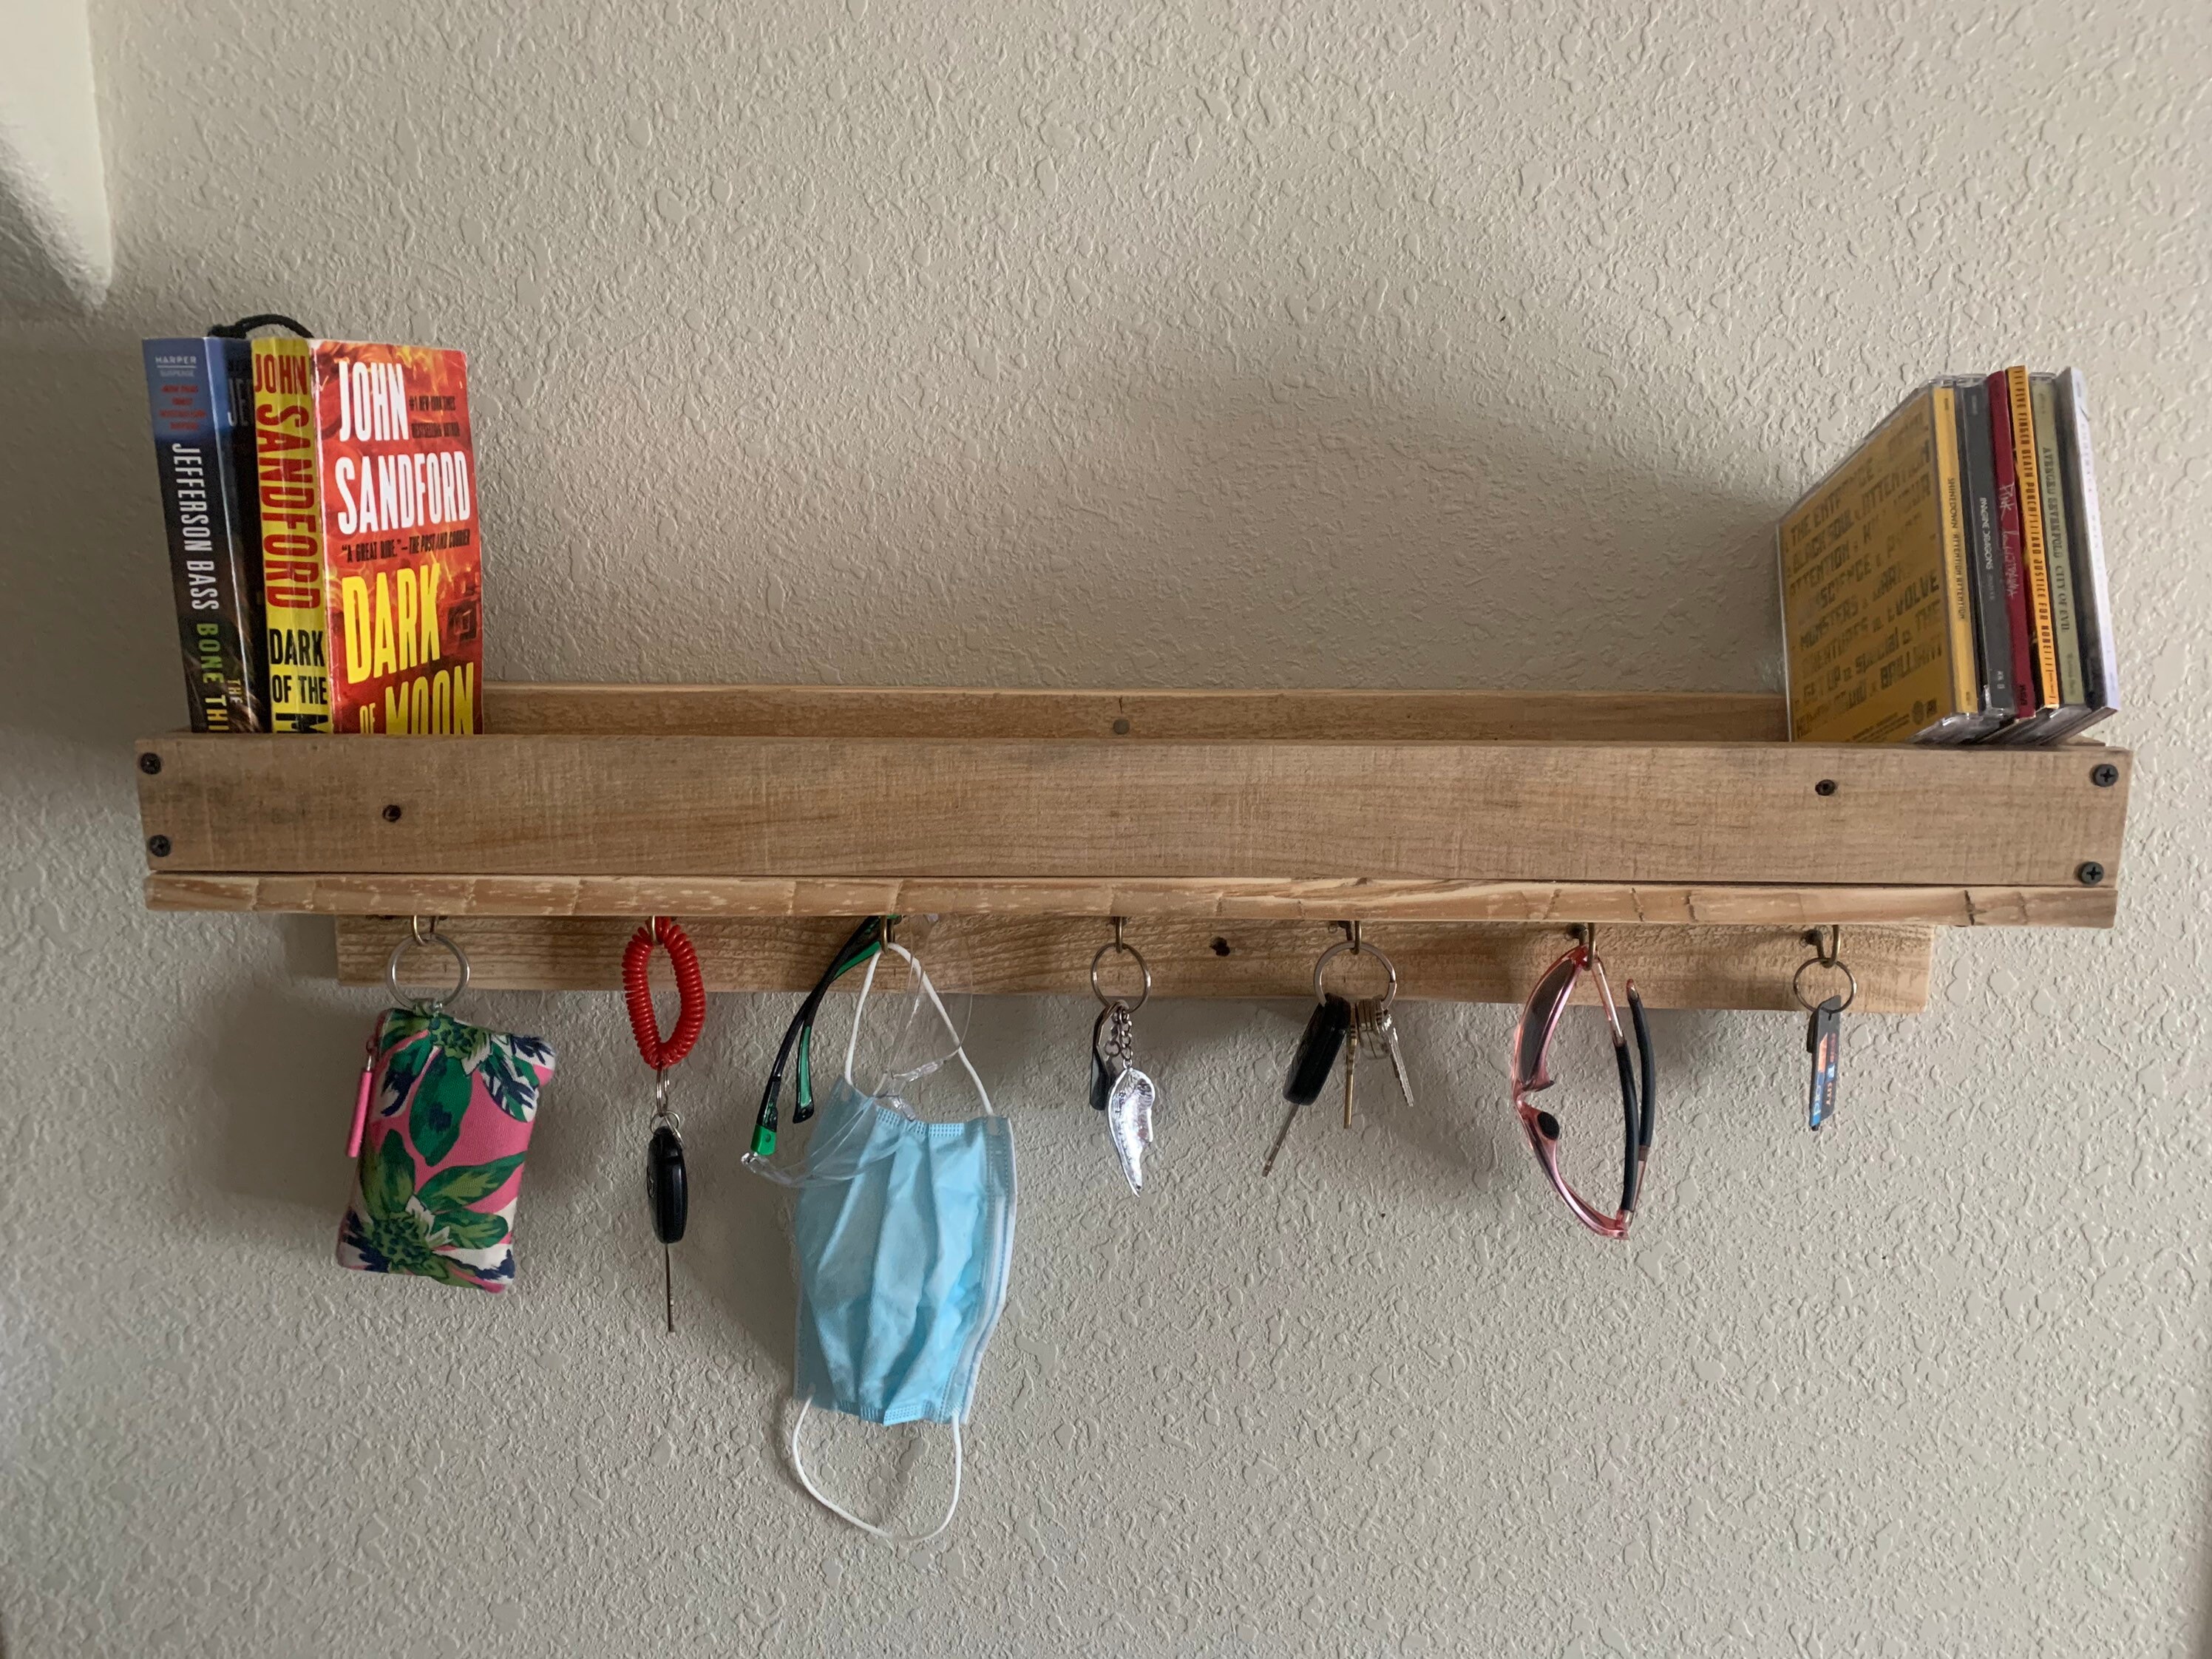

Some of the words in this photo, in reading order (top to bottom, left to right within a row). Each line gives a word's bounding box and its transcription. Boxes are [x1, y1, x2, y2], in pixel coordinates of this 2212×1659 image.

[155, 356, 197, 364] HARPER
[254, 353, 308, 396] JOHN
[339, 361, 409, 442] JOHN
[2018, 413, 2030, 445] FINGER
[2021, 449, 2034, 478] DEATH
[2042, 447, 2056, 495] AVENGED
[172, 443, 212, 551] JEFFERSON
[255, 403, 321, 609] SANDFORD
[335, 450, 471, 535] SANDFORD
[1947, 478, 1958, 529] SHINEDOWN
[356, 541, 377, 562] GREAT
[1952, 534, 1962, 575] ATTENTION
[186, 560, 220, 610] BASS
[2034, 559, 2046, 599] JUSTICE
[2055, 565, 2067, 589] CITY
[1955, 577, 1965, 620] ATTENTION
[2038, 603, 2049, 620] FOR
[2057, 593, 2068, 606] OF
[342, 562, 441, 685] DARK
[2059, 609, 2070, 633] EVIL
[197, 623, 225, 684] BONE
[269, 628, 325, 667] DARK
[272, 674, 292, 703] OF
[297, 675, 329, 705] THE
[384, 661, 475, 734] MOON
